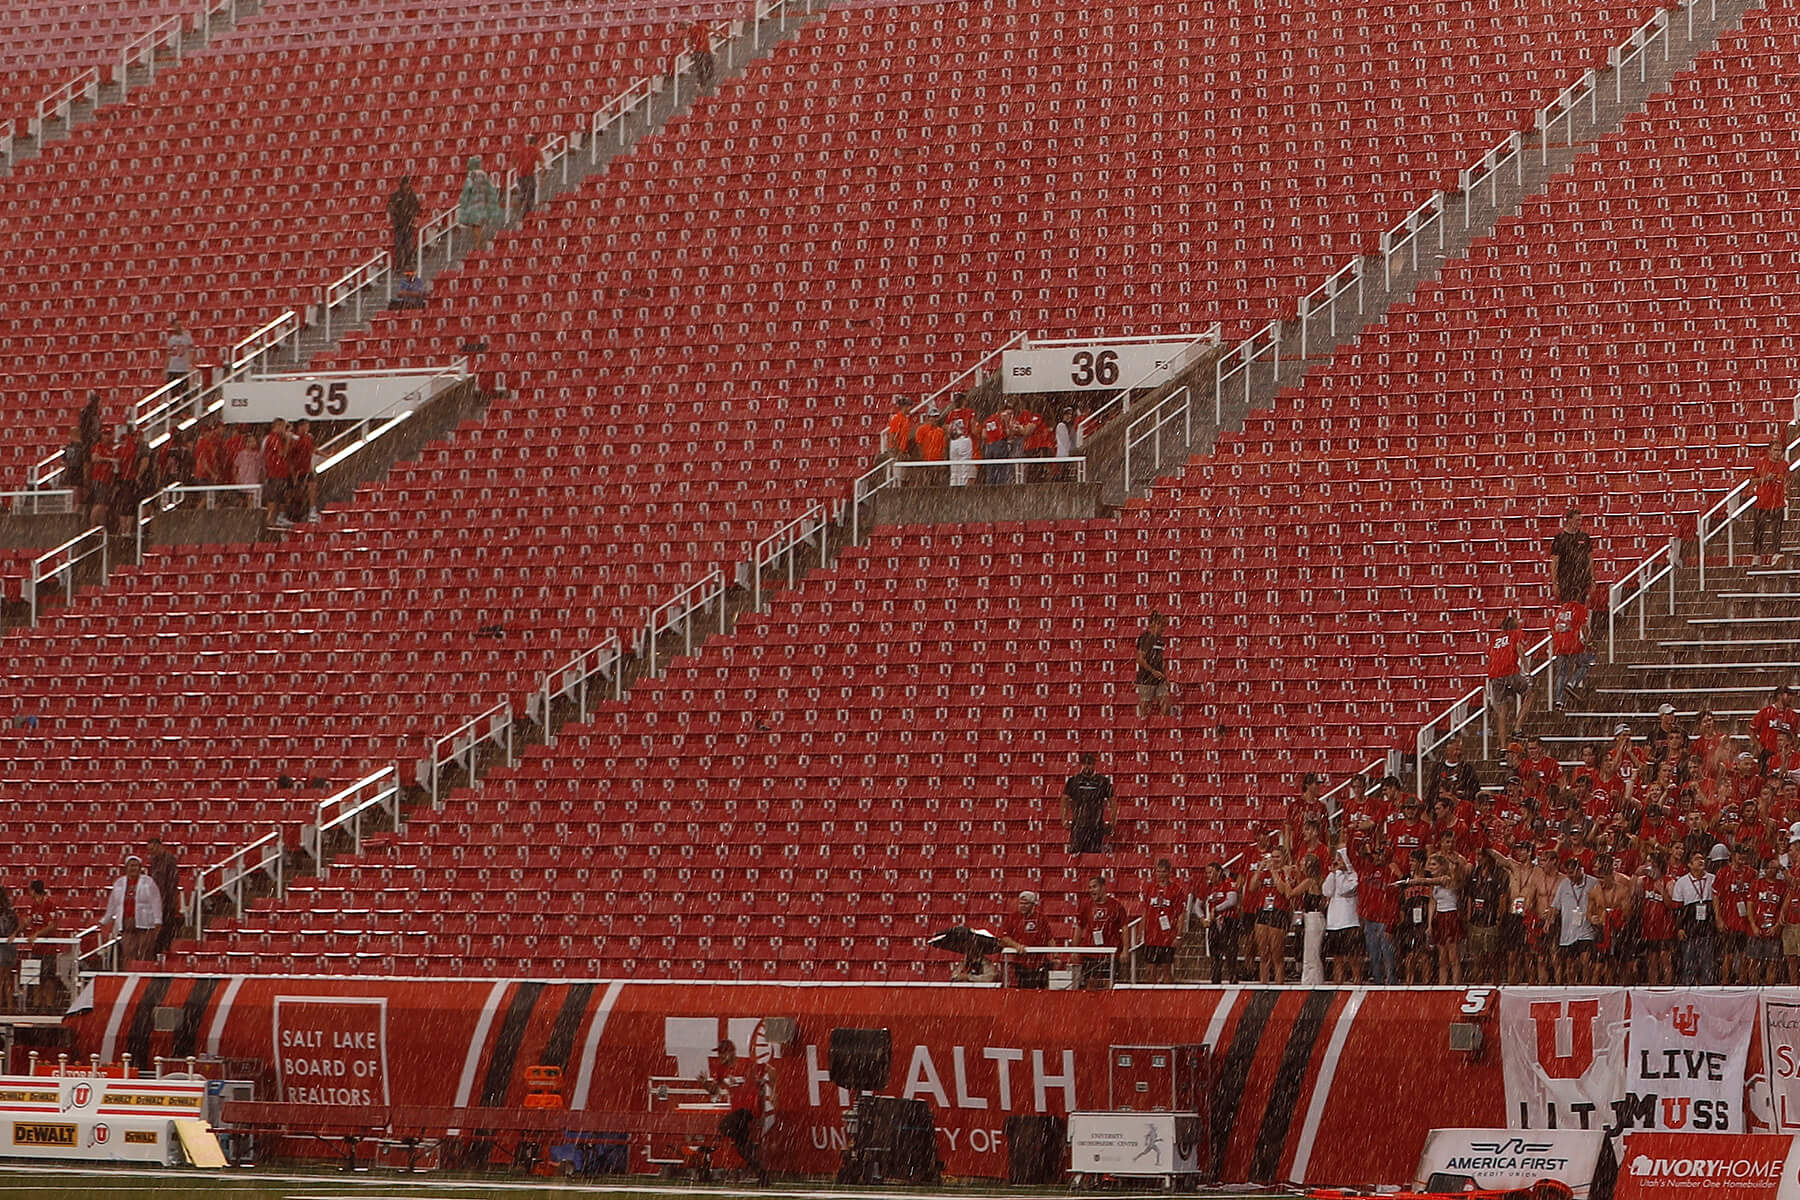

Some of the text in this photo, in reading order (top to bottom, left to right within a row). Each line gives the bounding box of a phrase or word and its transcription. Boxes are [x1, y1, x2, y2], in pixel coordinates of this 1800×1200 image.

[1013, 367, 1032, 377] E36
[1071, 350, 1120, 387] 36
[304, 382, 350, 417] 35
[1460, 989, 1491, 1015] 5
[282, 1030, 377, 1050] SALT LAKE
[1529, 999, 1599, 1079] U
[285, 1058, 378, 1078] BOARD OF
[1639, 1049, 1728, 1081] LIVE
[806, 1044, 1076, 1112] HALTH
[287, 1087, 371, 1106] REALTORS
[1625, 1092, 1729, 1131] MUSS
[969, 1128, 1003, 1153] OF
[1446, 1157, 1569, 1171] AMERICA FIRST
[1652, 1157, 1785, 1177] IVORYHOME
[1639, 1178, 1777, 1189] Utah's Number One Homebuilder
